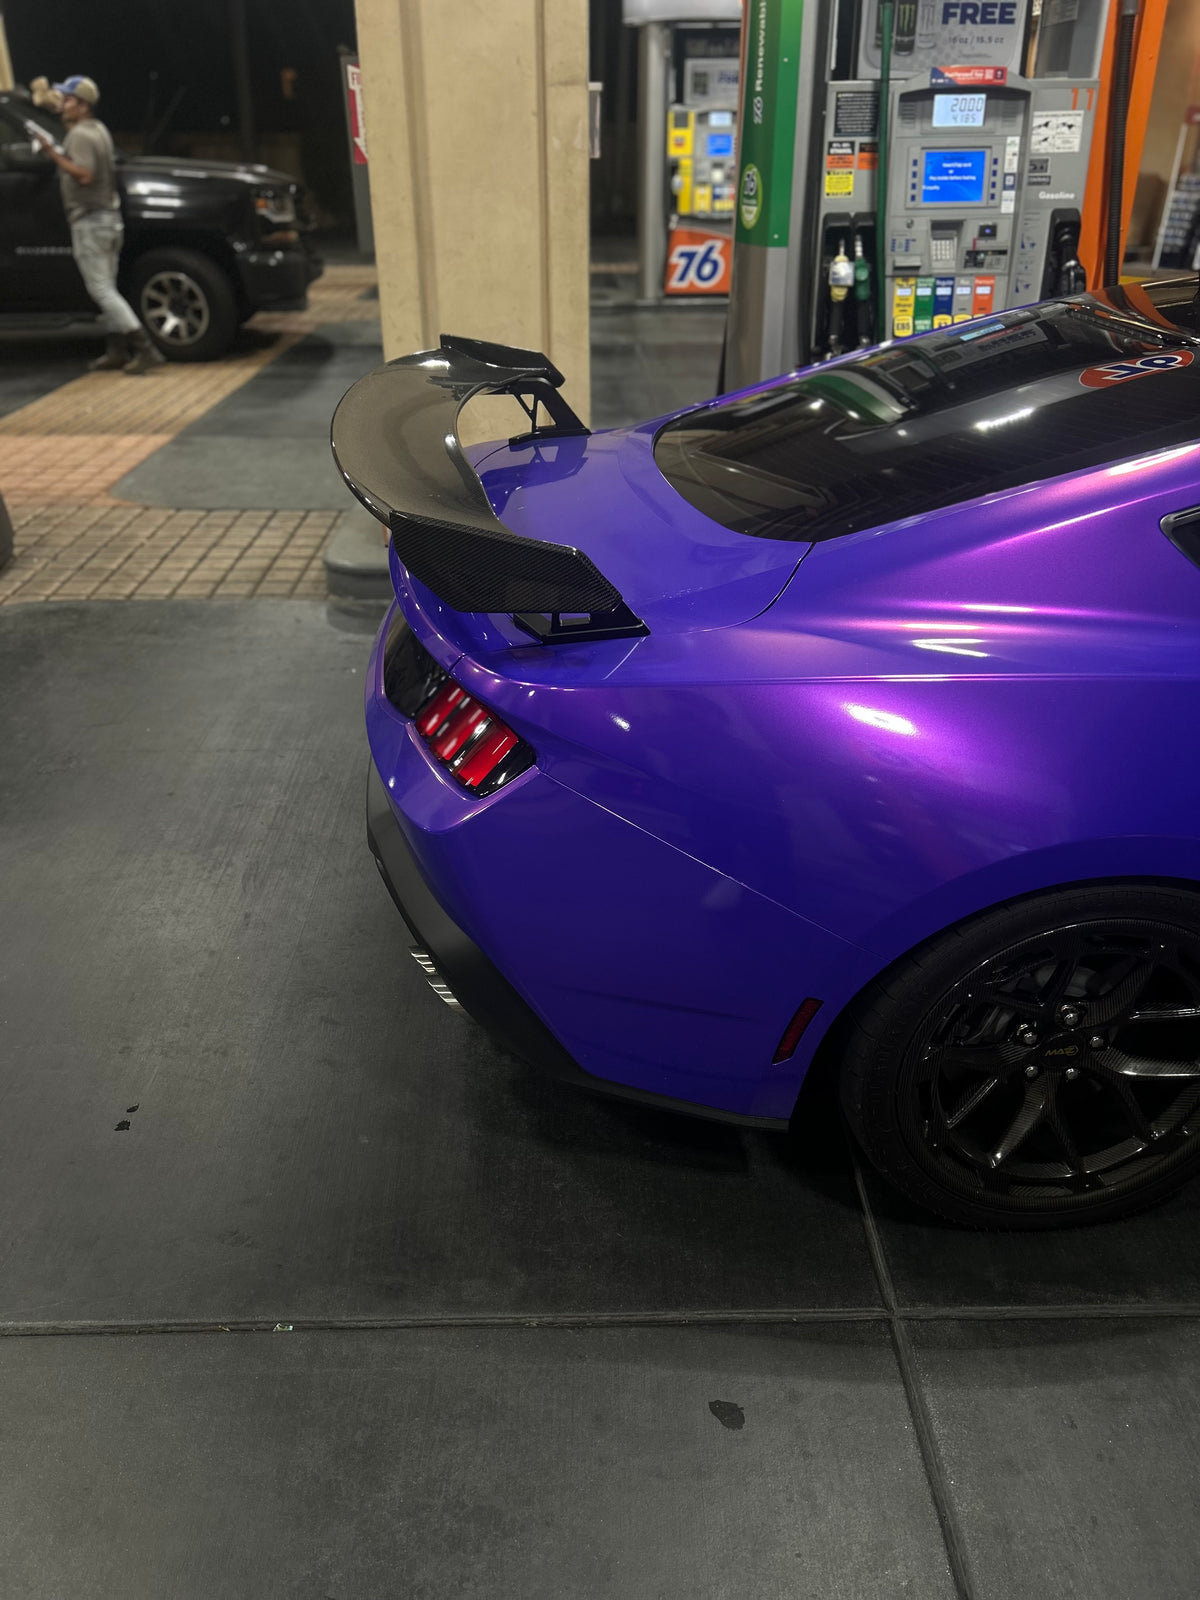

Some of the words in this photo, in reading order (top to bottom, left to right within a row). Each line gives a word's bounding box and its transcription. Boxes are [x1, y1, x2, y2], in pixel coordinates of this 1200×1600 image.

[941, 2, 1017, 25] FREE
[755, 0, 767, 91] Renewabl
[1071, 87, 1095, 111] 11
[1038, 191, 1075, 200] Gasoline
[672, 241, 724, 286] 76
